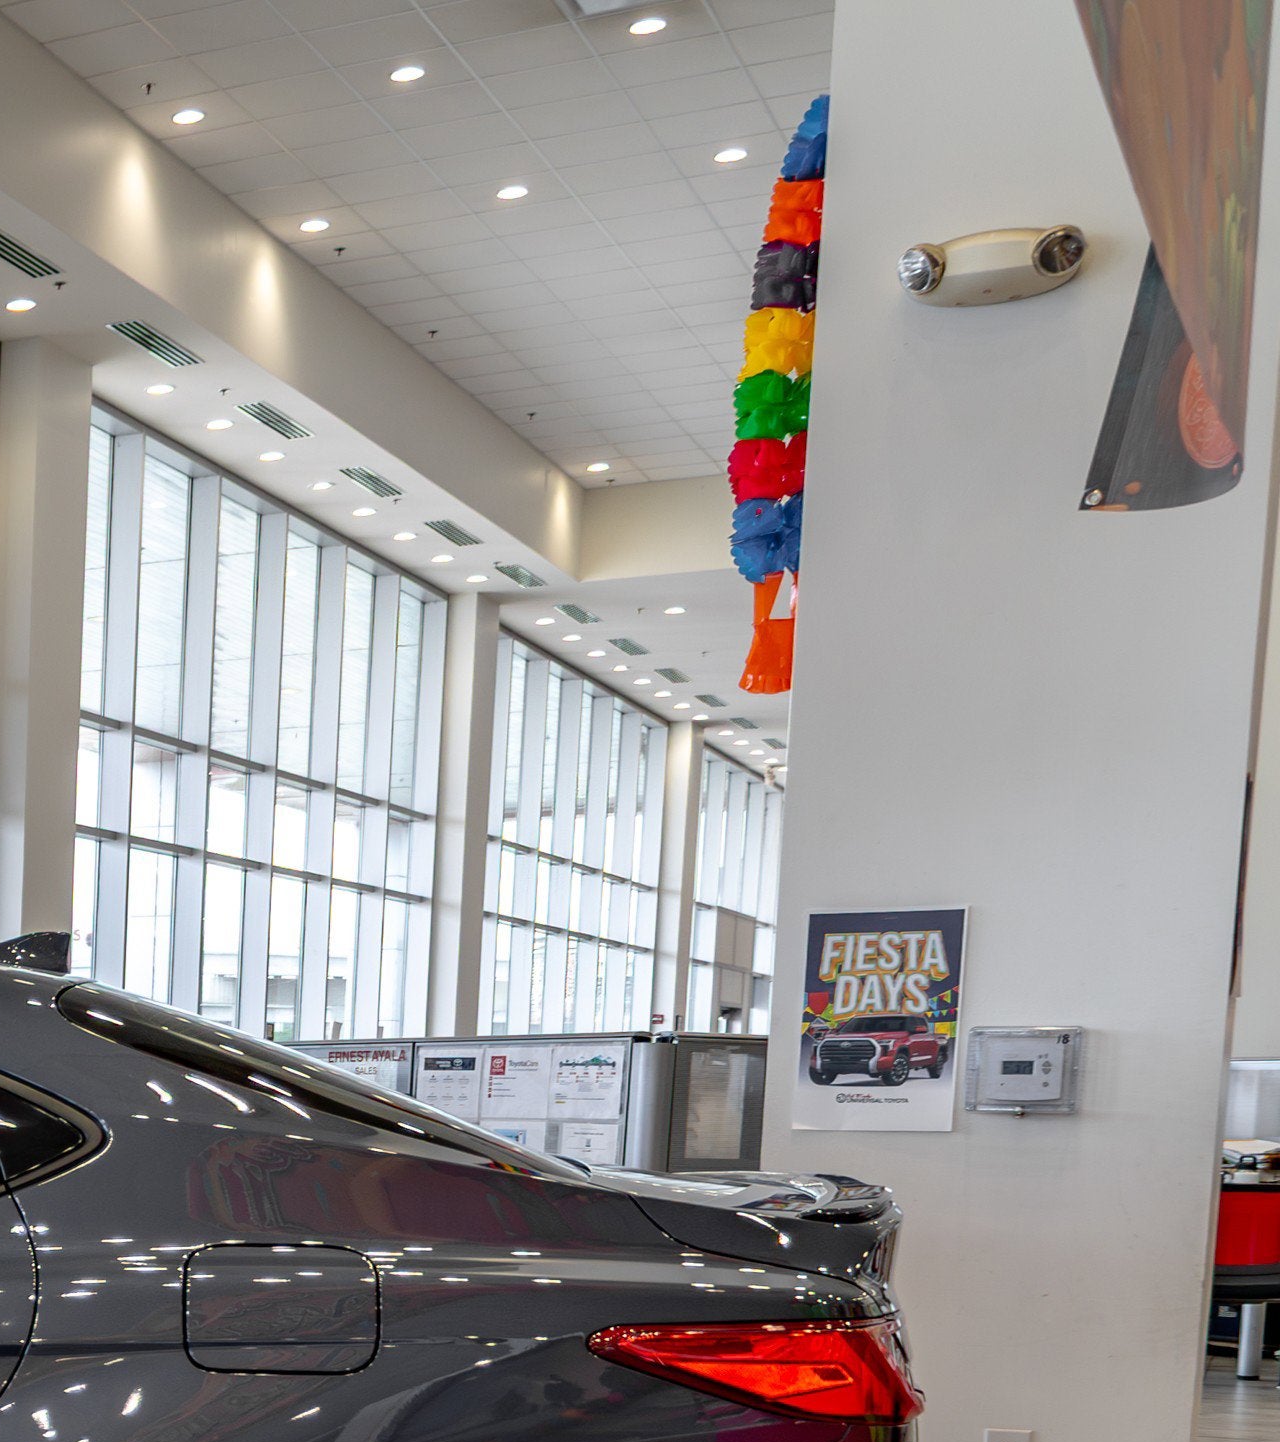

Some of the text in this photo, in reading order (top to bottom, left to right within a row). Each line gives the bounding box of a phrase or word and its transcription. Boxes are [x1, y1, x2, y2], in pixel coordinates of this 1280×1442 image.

[820, 930, 949, 976] FIESTA
[833, 972, 930, 1017] DAYS
[1056, 1033, 1070, 1044] 18
[328, 1050, 407, 1063] ERNEST AYALA
[355, 1066, 378, 1075] SALES
[508, 1060, 539, 1069] ToyotaCare
